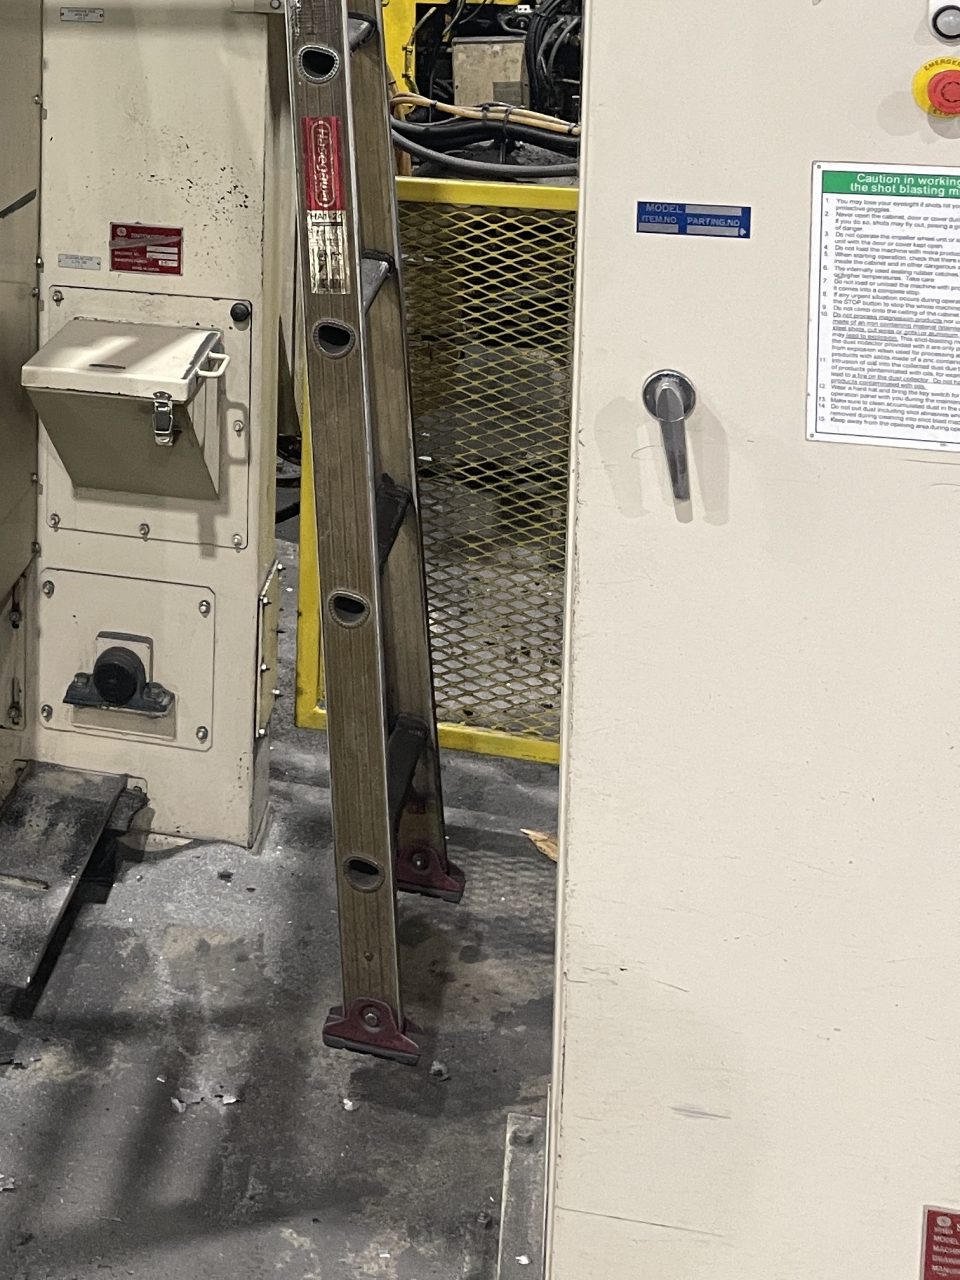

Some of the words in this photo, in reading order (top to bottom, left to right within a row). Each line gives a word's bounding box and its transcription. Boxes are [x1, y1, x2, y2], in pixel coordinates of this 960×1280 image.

[857, 173, 901, 185] Caution
[904, 174, 915, 185] in
[850, 183, 869, 192] the
[871, 183, 897, 193] shot
[899, 184, 946, 197] blasting
[646, 203, 683, 214] MODEL
[687, 217, 740, 227] PARTING.NO
